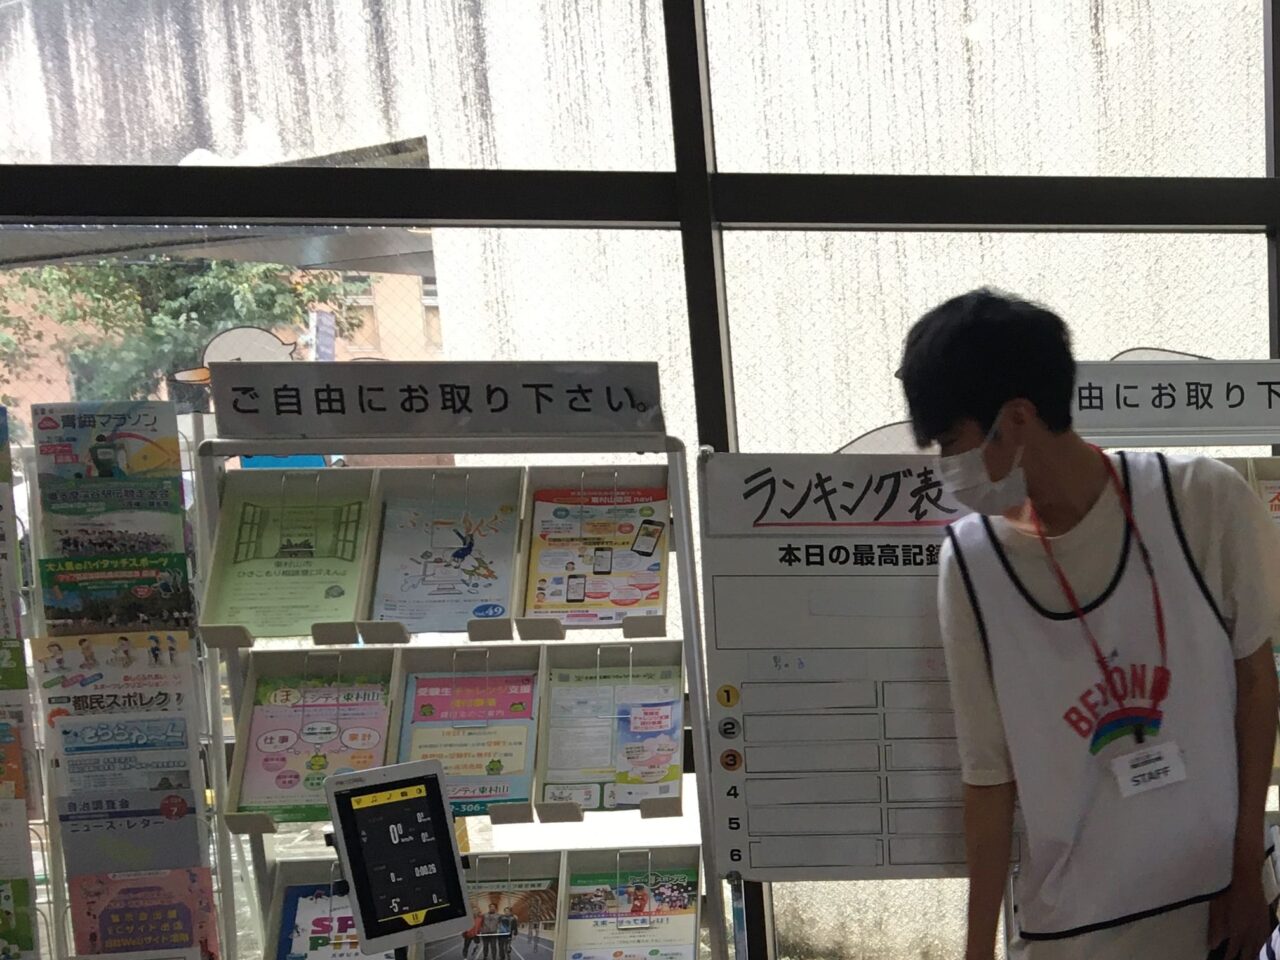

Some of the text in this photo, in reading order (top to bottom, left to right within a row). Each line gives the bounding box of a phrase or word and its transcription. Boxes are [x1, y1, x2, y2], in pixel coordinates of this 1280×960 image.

[231, 381, 651, 416] ご自由にお取り下さい。
[61, 413, 157, 428] 青梅マラソン
[743, 467, 960, 523] ランキング表
[778, 544, 940, 567] 本日の最高記録
[722, 690, 733, 703] 1
[1063, 664, 1172, 739] BEYOND
[722, 722, 736, 735] 2
[264, 735, 289, 745] 仕事
[725, 754, 737, 767] 3
[1131, 766, 1170, 787] STAFF
[726, 786, 739, 800] 4
[71, 819, 165, 833] ニュース・レター
[728, 818, 740, 831] 5
[730, 849, 742, 862] 6
